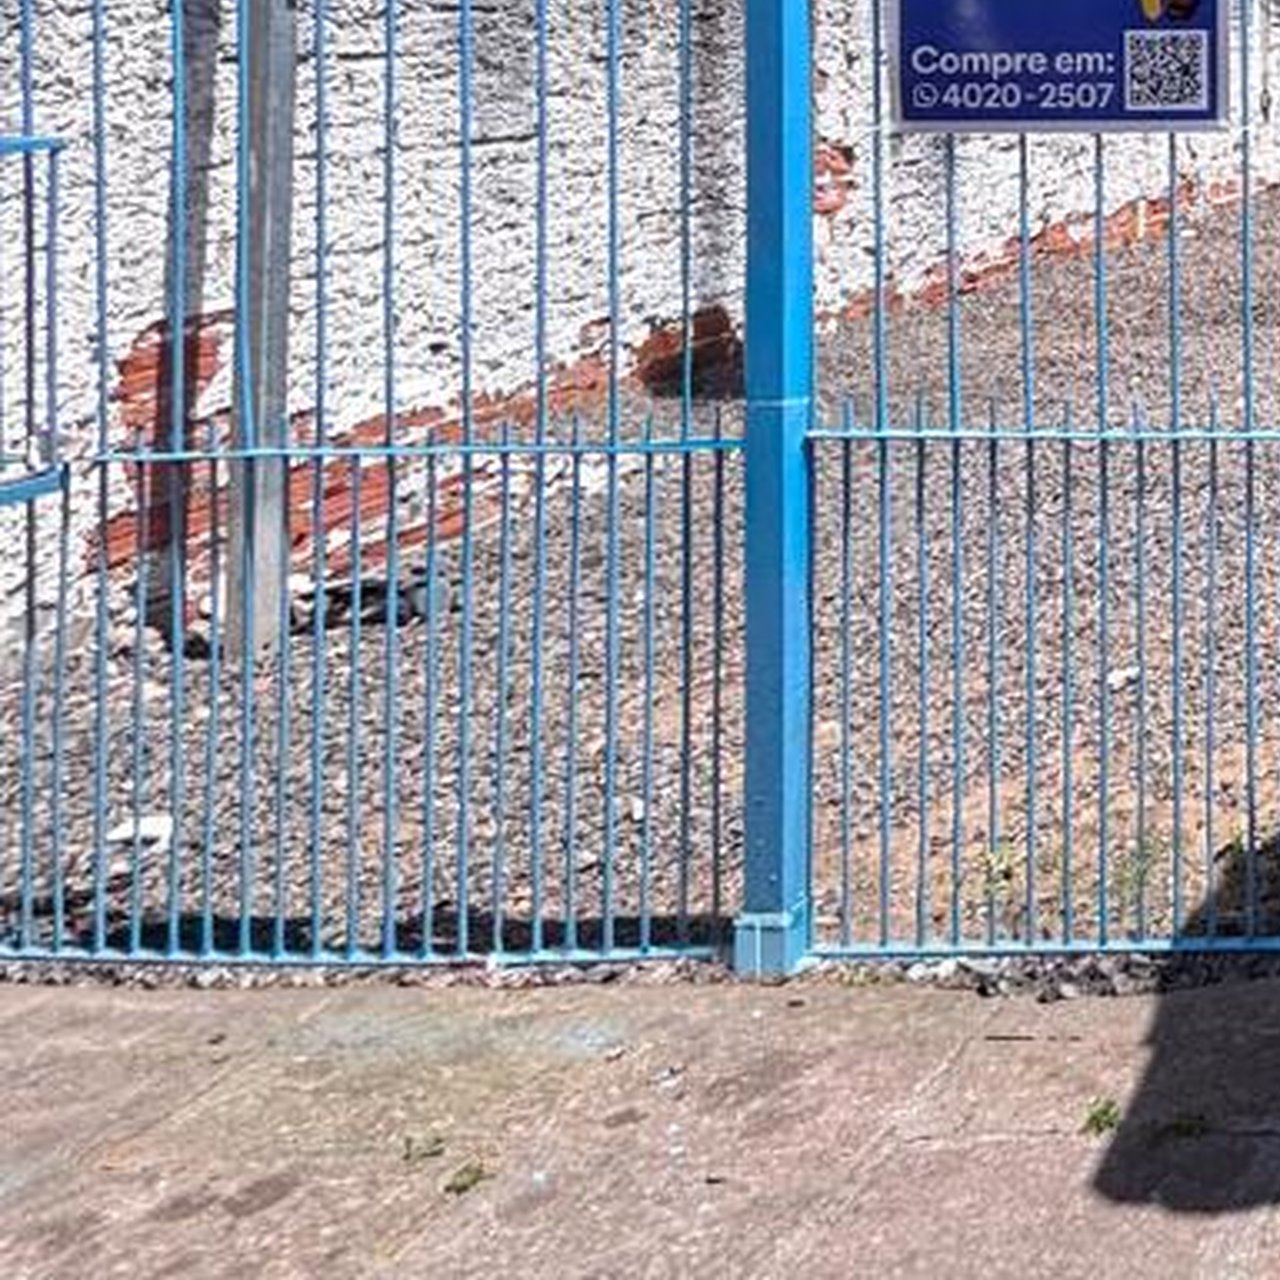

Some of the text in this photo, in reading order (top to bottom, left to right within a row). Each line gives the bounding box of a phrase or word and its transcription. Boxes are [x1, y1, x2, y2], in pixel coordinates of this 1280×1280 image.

[911, 45, 1115, 81] Compre em:
[942, 83, 1115, 109] 4020-2507
